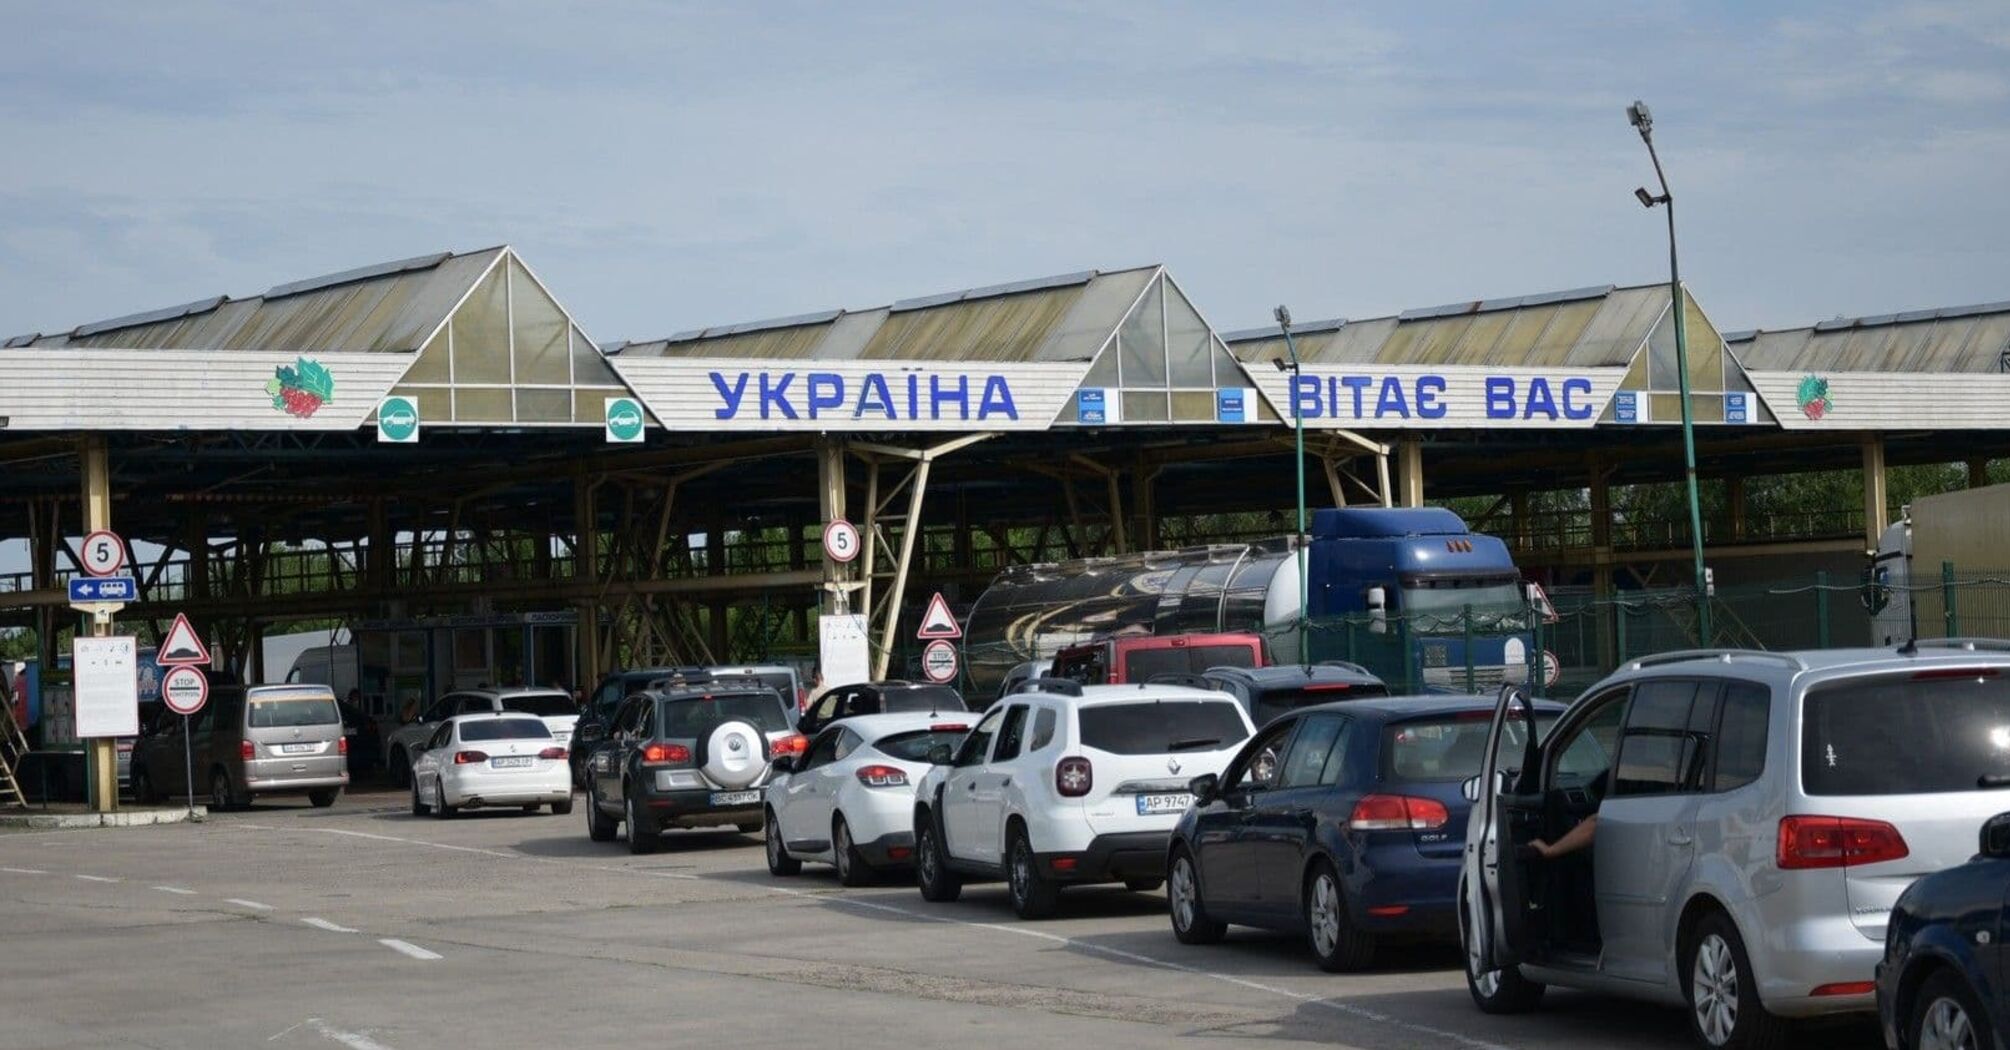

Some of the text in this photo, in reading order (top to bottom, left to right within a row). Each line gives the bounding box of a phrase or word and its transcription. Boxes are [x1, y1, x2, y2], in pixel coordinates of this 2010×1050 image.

[708, 367, 1019, 420] УКРАЇНА
[1288, 375, 1592, 420] ВІТАЄ ВАС
[837, 532, 848, 550] 5
[96, 543, 109, 563] 5
[175, 678, 195, 686] STOP
[1147, 795, 1190, 808] AP 9747
